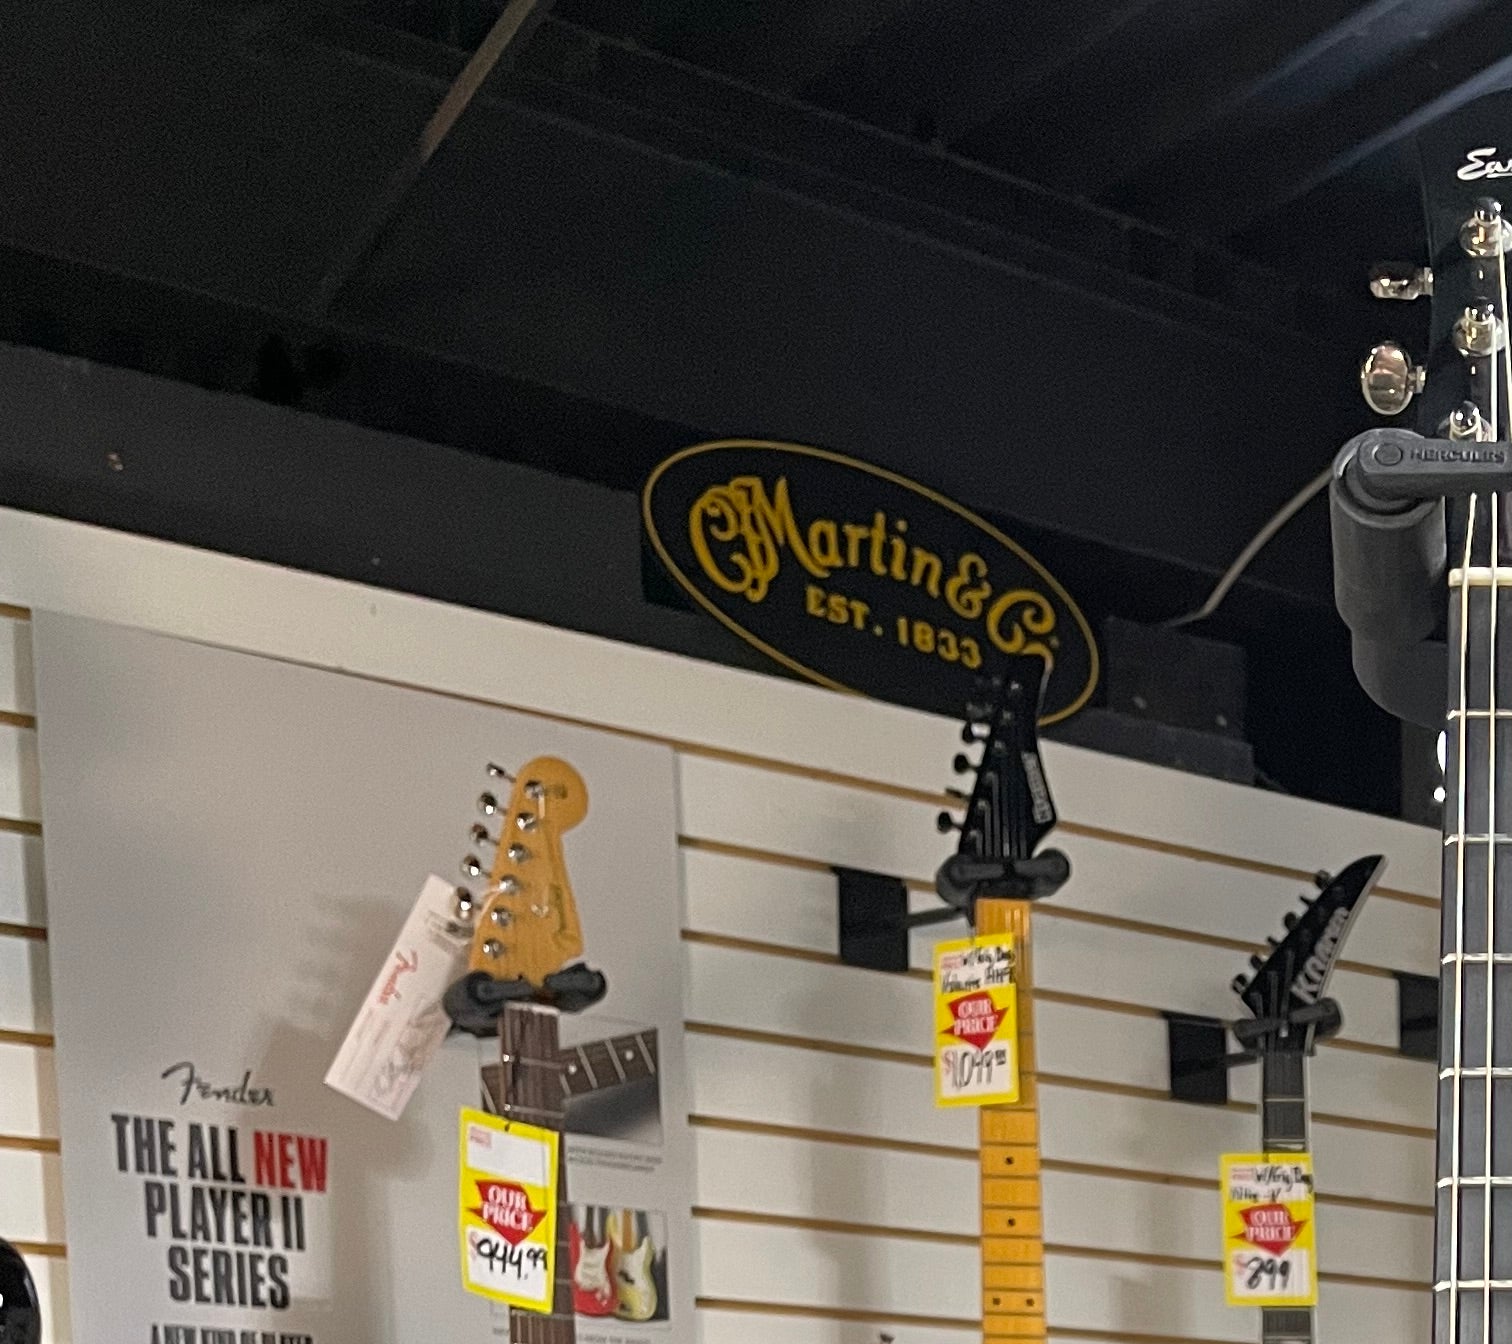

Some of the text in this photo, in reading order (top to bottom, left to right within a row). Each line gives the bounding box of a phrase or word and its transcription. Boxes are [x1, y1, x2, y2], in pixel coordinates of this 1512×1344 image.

[1411, 448, 1505, 464] HERCULES
[805, 585, 984, 670] EST. 1833
[957, 1000, 993, 1018] OUR
[953, 1016, 998, 1036] PRICE
[161, 1061, 275, 1106] Fender
[110, 1113, 329, 1194] THE ALL NEW
[487, 1184, 527, 1211] OUR
[143, 1180, 307, 1252] PLAYER II
[481, 1201, 534, 1232] PRICE
[1252, 1210, 1288, 1226] OUR
[1249, 1224, 1294, 1242] PRICE
[166, 1245, 291, 1312] SERIES
